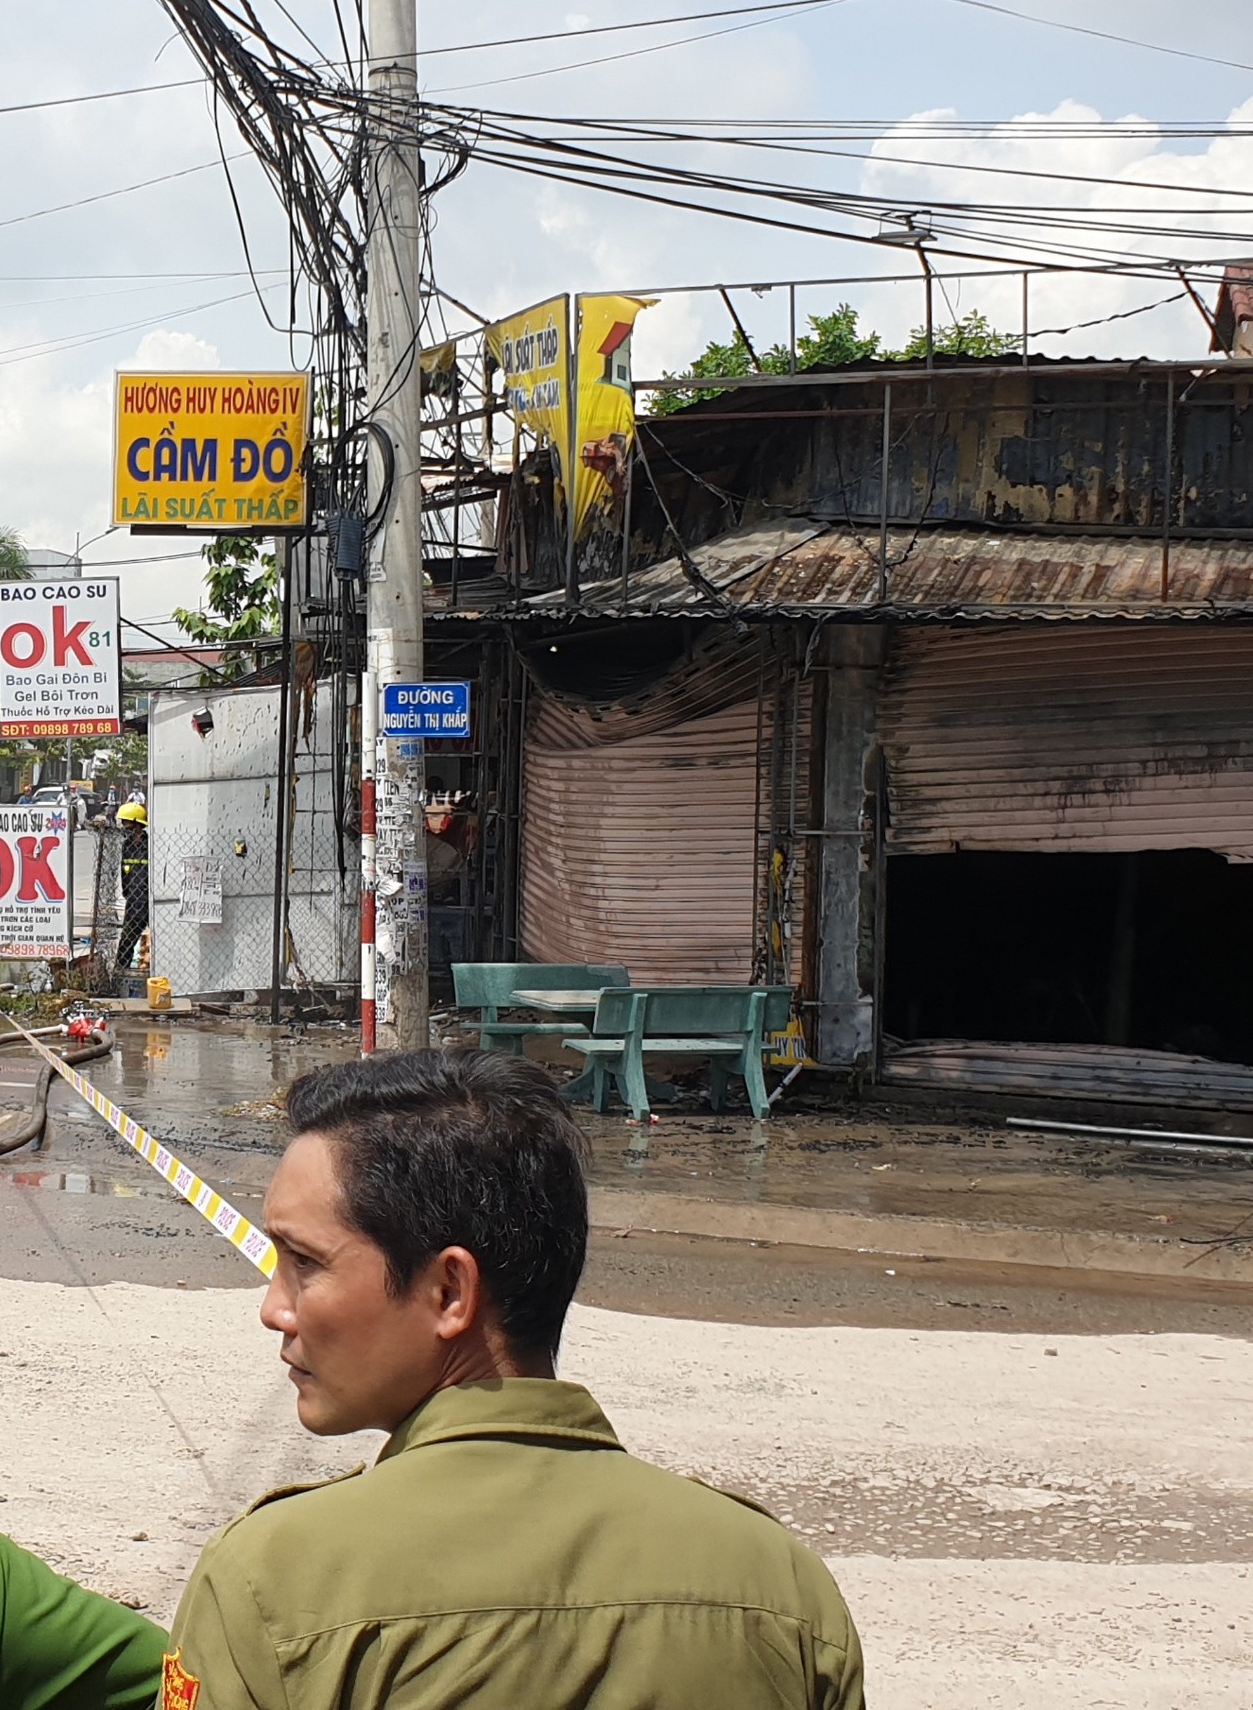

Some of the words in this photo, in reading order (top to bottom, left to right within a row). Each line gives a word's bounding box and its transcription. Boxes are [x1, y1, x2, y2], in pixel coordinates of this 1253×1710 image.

[124, 382, 182, 414] HƯƠNG
[186, 387, 217, 414] HUY
[222, 379, 279, 414] HOÀNG
[282, 387, 300, 414] IV
[127, 421, 218, 482] CẦM
[230, 421, 293, 483] ĐỒ
[121, 492, 159, 519] LÃI
[165, 488, 227, 519] SUẤT
[233, 489, 297, 520] THẤP
[1, 587, 36, 601] BAO
[42, 586, 80, 600] CAO
[87, 585, 107, 598] SU
[89, 631, 111, 647] 81
[6, 675, 32, 686] Bao
[36, 674, 58, 685] Gai
[62, 673, 89, 684] Đôn
[14, 690, 36, 702] Gel
[41, 690, 63, 701] Bôi
[67, 689, 99, 700] Trơn
[398, 687, 453, 704] ĐƯỜNG
[1, 706, 33, 717] Thuốc
[53, 706, 71, 717] Trợ
[74, 705, 94, 715] Kéo
[384, 706, 421, 728] NGUYỄN
[424, 713, 439, 730] THỊ
[33, 724, 69, 735] 09898
[72, 723, 93, 734] 789
[97, 722, 112, 733] 68
[12, 813, 28, 832] CAO
[30, 813, 43, 832] SU
[36, 935, 54, 943] QUAN
